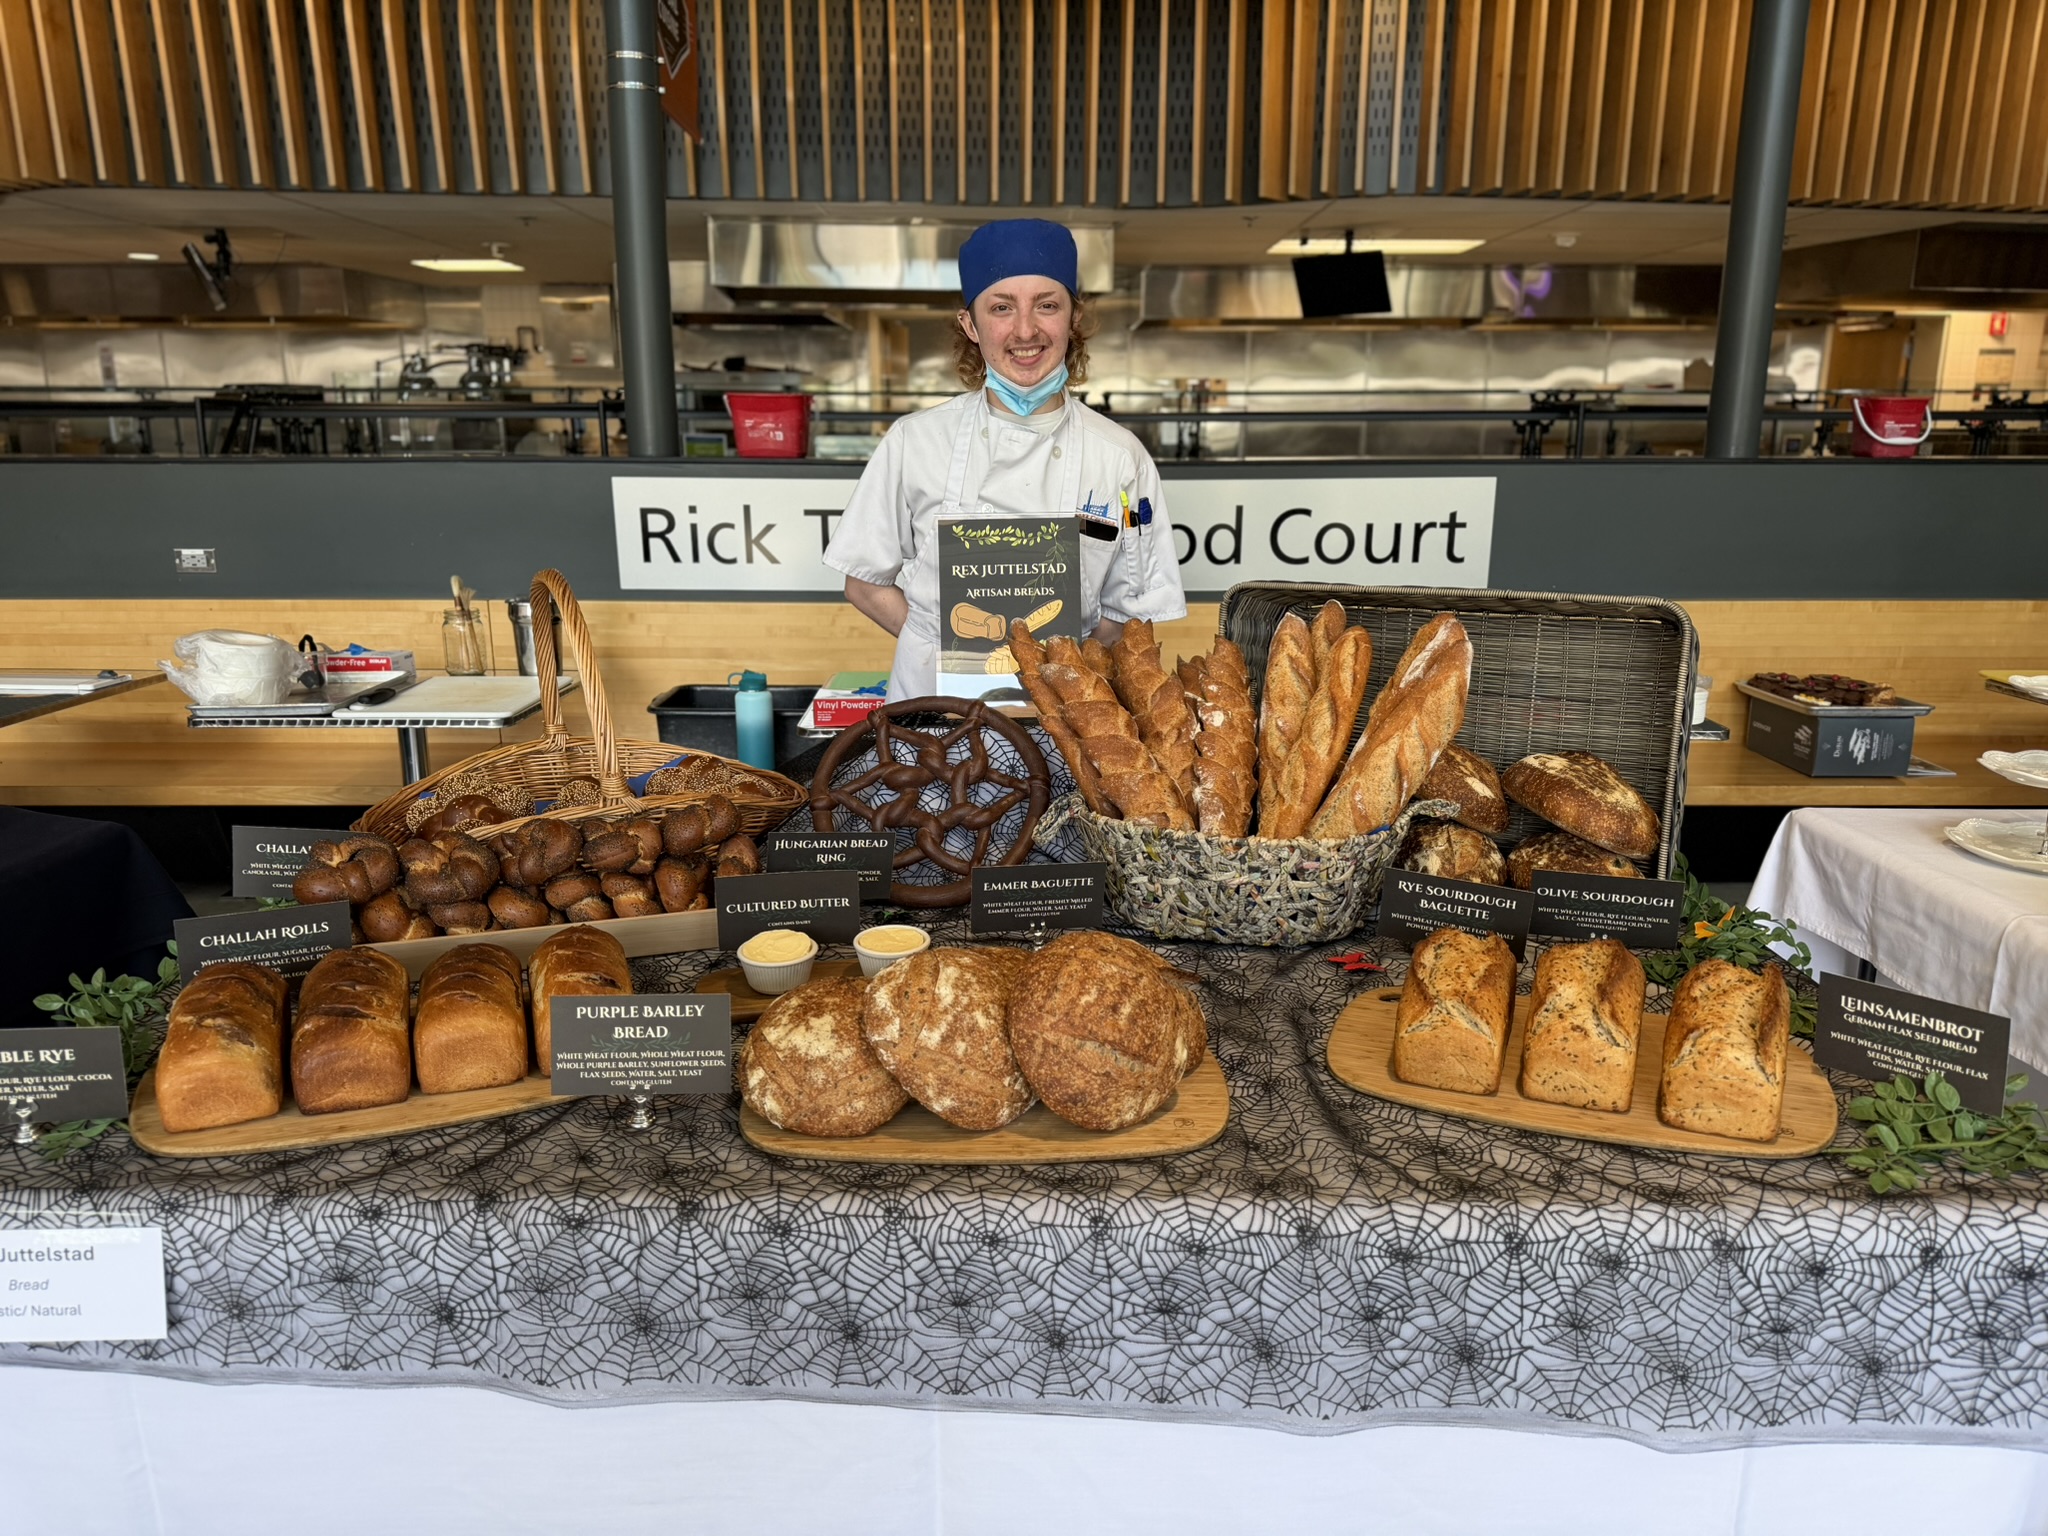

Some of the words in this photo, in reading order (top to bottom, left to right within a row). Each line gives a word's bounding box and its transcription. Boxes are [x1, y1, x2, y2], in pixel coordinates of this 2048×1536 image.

[639, 504, 781, 564] Rick
[1171, 505, 1244, 565] od
[1269, 508, 1467, 565] Court
[952, 564, 979, 577] REX
[981, 562, 1067, 578] JUTTELSTAD
[966, 587, 1011, 600] ARTISAN
[1014, 587, 1055, 597] BREADS
[817, 701, 838, 710] Vinyl
[841, 701, 885, 709] Powder-Fr
[775, 839, 848, 851] HUNGARIAN
[850, 839, 888, 849] BREAD
[816, 853, 846, 865] RING
[983, 881, 1028, 892] EMMER
[1031, 877, 1094, 889] BAGUETTE
[1398, 880, 1423, 893] RYE
[1425, 885, 1517, 910] SOURDOUGH
[1537, 887, 1578, 900] OLIVE
[1581, 891, 1675, 908] SOURDOUGH
[726, 900, 797, 914] CULTURED
[799, 897, 850, 909] BUTTER
[1419, 898, 1490, 920] BAGUETTE
[200, 929, 277, 948] CHALLAH
[281, 921, 330, 939] ROLLS
[576, 1006, 639, 1019] PURPLE
[642, 1004, 705, 1018] BARLEY
[1840, 995, 1985, 1042] LEINSAMENBROT
[613, 1025, 668, 1039] BREAD
[1843, 1012, 1886, 1031] GERMAN
[1887, 1024, 1912, 1038] FLAX
[1914, 1031, 1941, 1045] SEED
[1942, 1038, 1978, 1054] BREAD
[0, 1050, 35, 1063] BLE
[39, 1048, 76, 1064] RYE
[557, 1051, 583, 1060] WHITE
[584, 1051, 609, 1060] WHEAT
[640, 1050, 669, 1059] WHOLE
[670, 1050, 695, 1058] WHEAT
[1830, 1031, 1857, 1044] WHITE
[1857, 1038, 1882, 1050] WHEAT
[1915, 1054, 1931, 1064] RYE
[1965, 1068, 1989, 1080] FLAX
[1866, 1050, 1894, 1063] SEEDS,
[556, 1061, 585, 1070] WHOLE
[586, 1061, 617, 1069] PURPLE
[618, 1061, 649, 1069] BARLEY,
[650, 1060, 699, 1068] SUNFLOWER
[700, 1059, 726, 1067] SEEDS,
[1872, 1060, 1908, 1075] CONTAINS
[23, 1076, 41, 1085] RYE
[77, 1073, 113, 1081] COCOA
[601, 1070, 627, 1078] SEEDS,
[48, 1083, 70, 1091] SALT
[0, 1246, 95, 1263] Juttelstad
[8, 1279, 50, 1291] Bread
[0, 1305, 27, 1317] stic/
[31, 1304, 82, 1317] Natural
